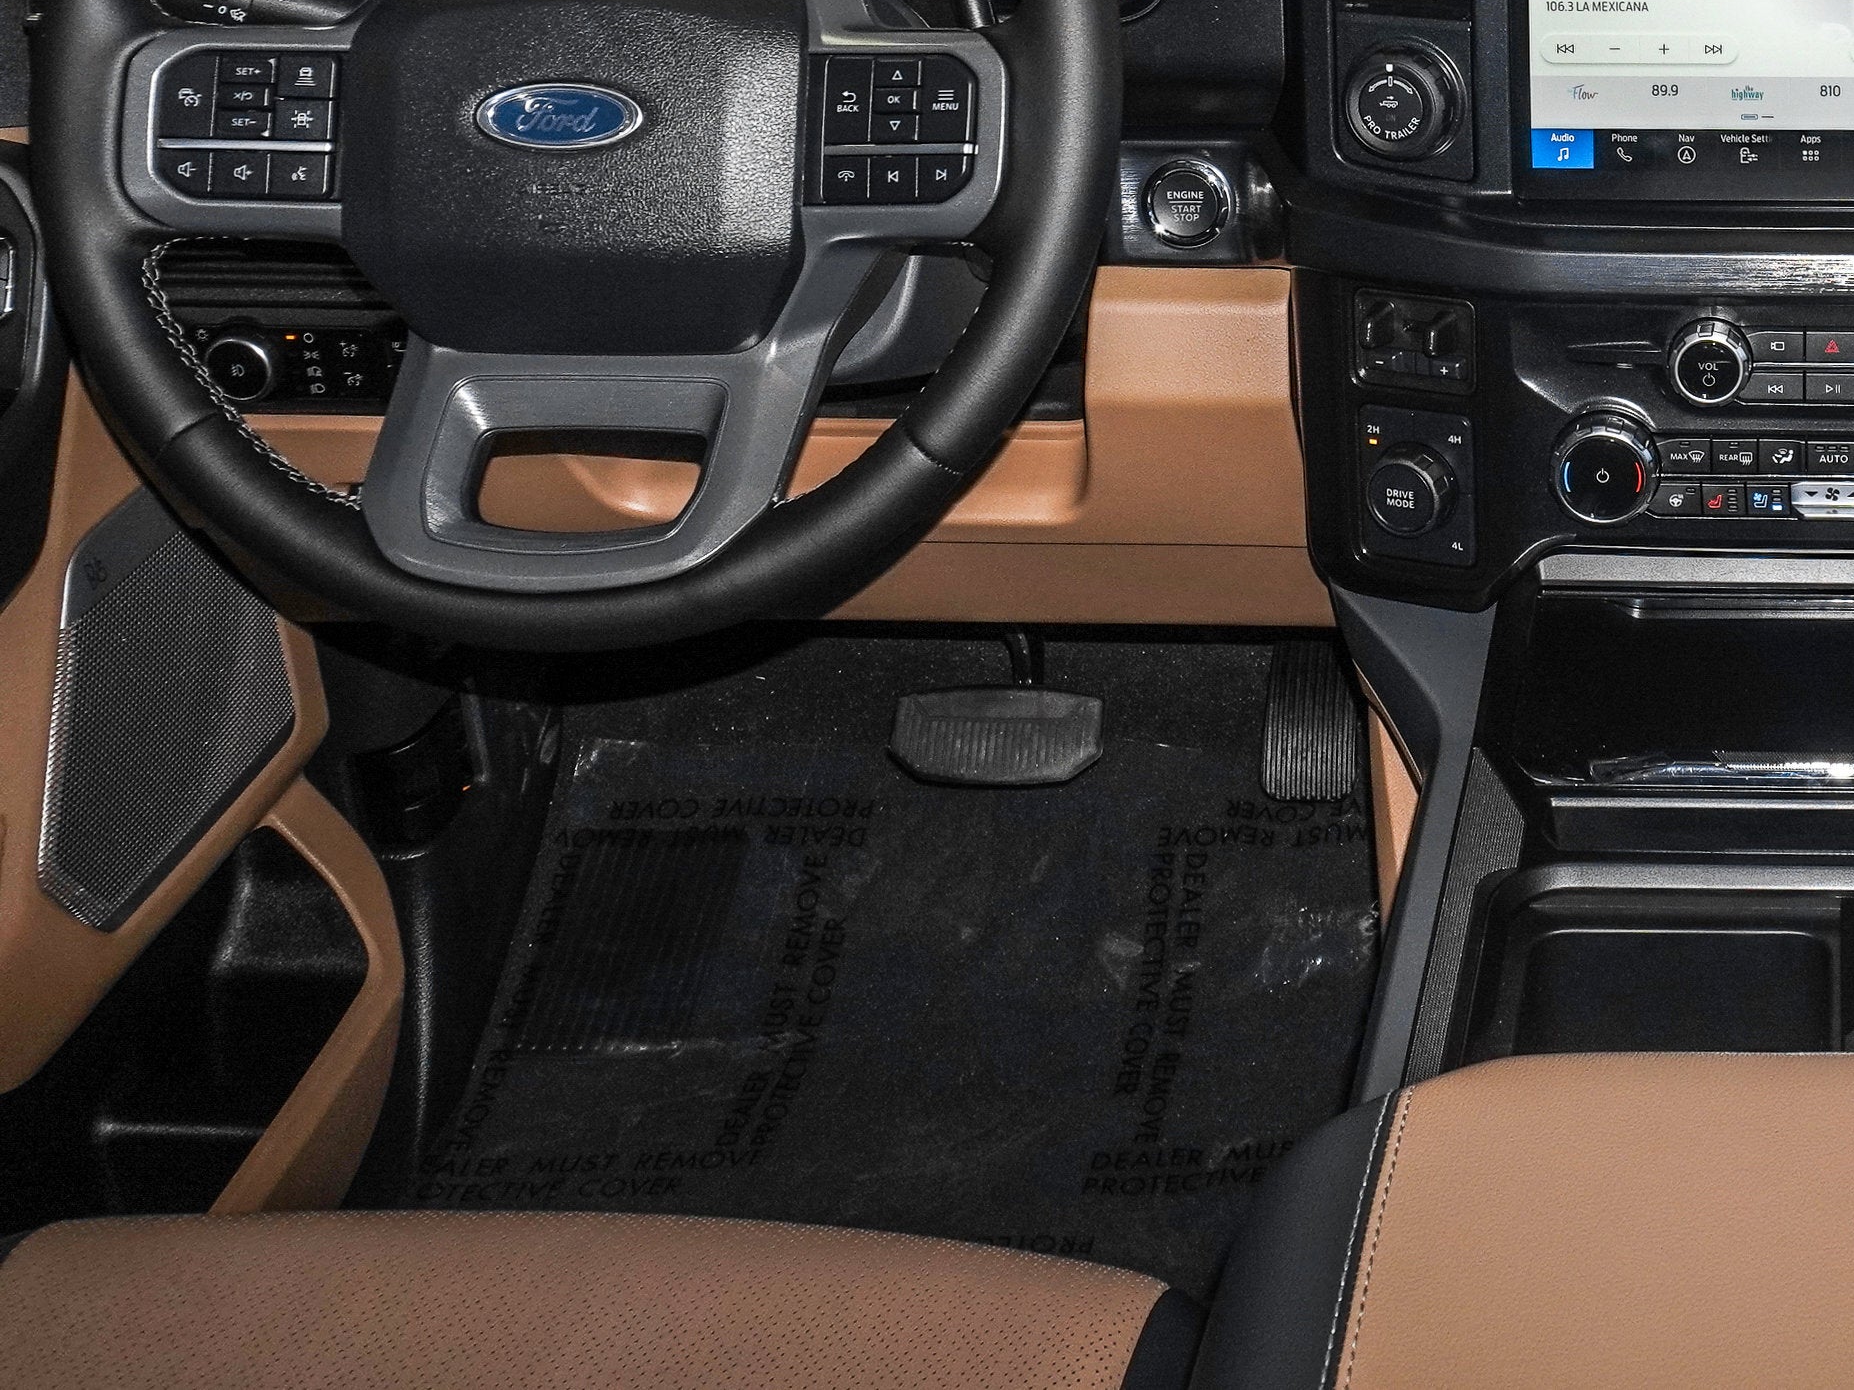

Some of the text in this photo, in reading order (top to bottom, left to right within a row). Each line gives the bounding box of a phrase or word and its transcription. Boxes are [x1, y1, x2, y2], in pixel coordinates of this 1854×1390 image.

[1546, 1, 1649, 12] 106.3 LA MEXICANA
[1571, 83, 1599, 100] Flow
[1651, 85, 1679, 97] 89.9
[1731, 88, 1764, 101] highway
[1819, 85, 1841, 97] 810
[887, 95, 901, 104] OK
[836, 104, 860, 113] BACK
[932, 102, 960, 111] MENU
[515, 97, 600, 133] Ford
[1363, 115, 1421, 140] PRO TRAILER
[1550, 133, 1575, 143] Audio
[1611, 133, 1638, 143] Phone
[1678, 134, 1695, 143] Nav
[1720, 134, 1750, 143] Vehicle
[1800, 135, 1822, 145] Apps
[1166, 191, 1205, 200] ENGINE
[1171, 204, 1202, 214] START
[1173, 213, 1200, 222] STOP
[1698, 361, 1719, 372] VOL
[1366, 425, 1380, 434] 2H
[1447, 435, 1462, 445] 4H
[1670, 452, 1688, 462] MAX
[1718, 452, 1739, 462] REAR
[1819, 454, 1849, 464] AUTO
[1386, 488, 1415, 500] DRIVE
[1386, 498, 1415, 509] MODE
[1451, 542, 1464, 551] 4L
[608, 796, 875, 821] PROTECTIVE COVER
[763, 824, 867, 848] DEALER
[780, 853, 830, 968] REMOVE
[806, 914, 848, 1006] COVER
[1112, 852, 1176, 1099] PROTECTIVE COVER
[1133, 851, 1209, 1145] DEALER MUST REMOVE
[528, 1149, 765, 1175] MUST REMOVE
[1089, 1148, 1202, 1172] DEALER
[577, 1176, 683, 1199] COVER
